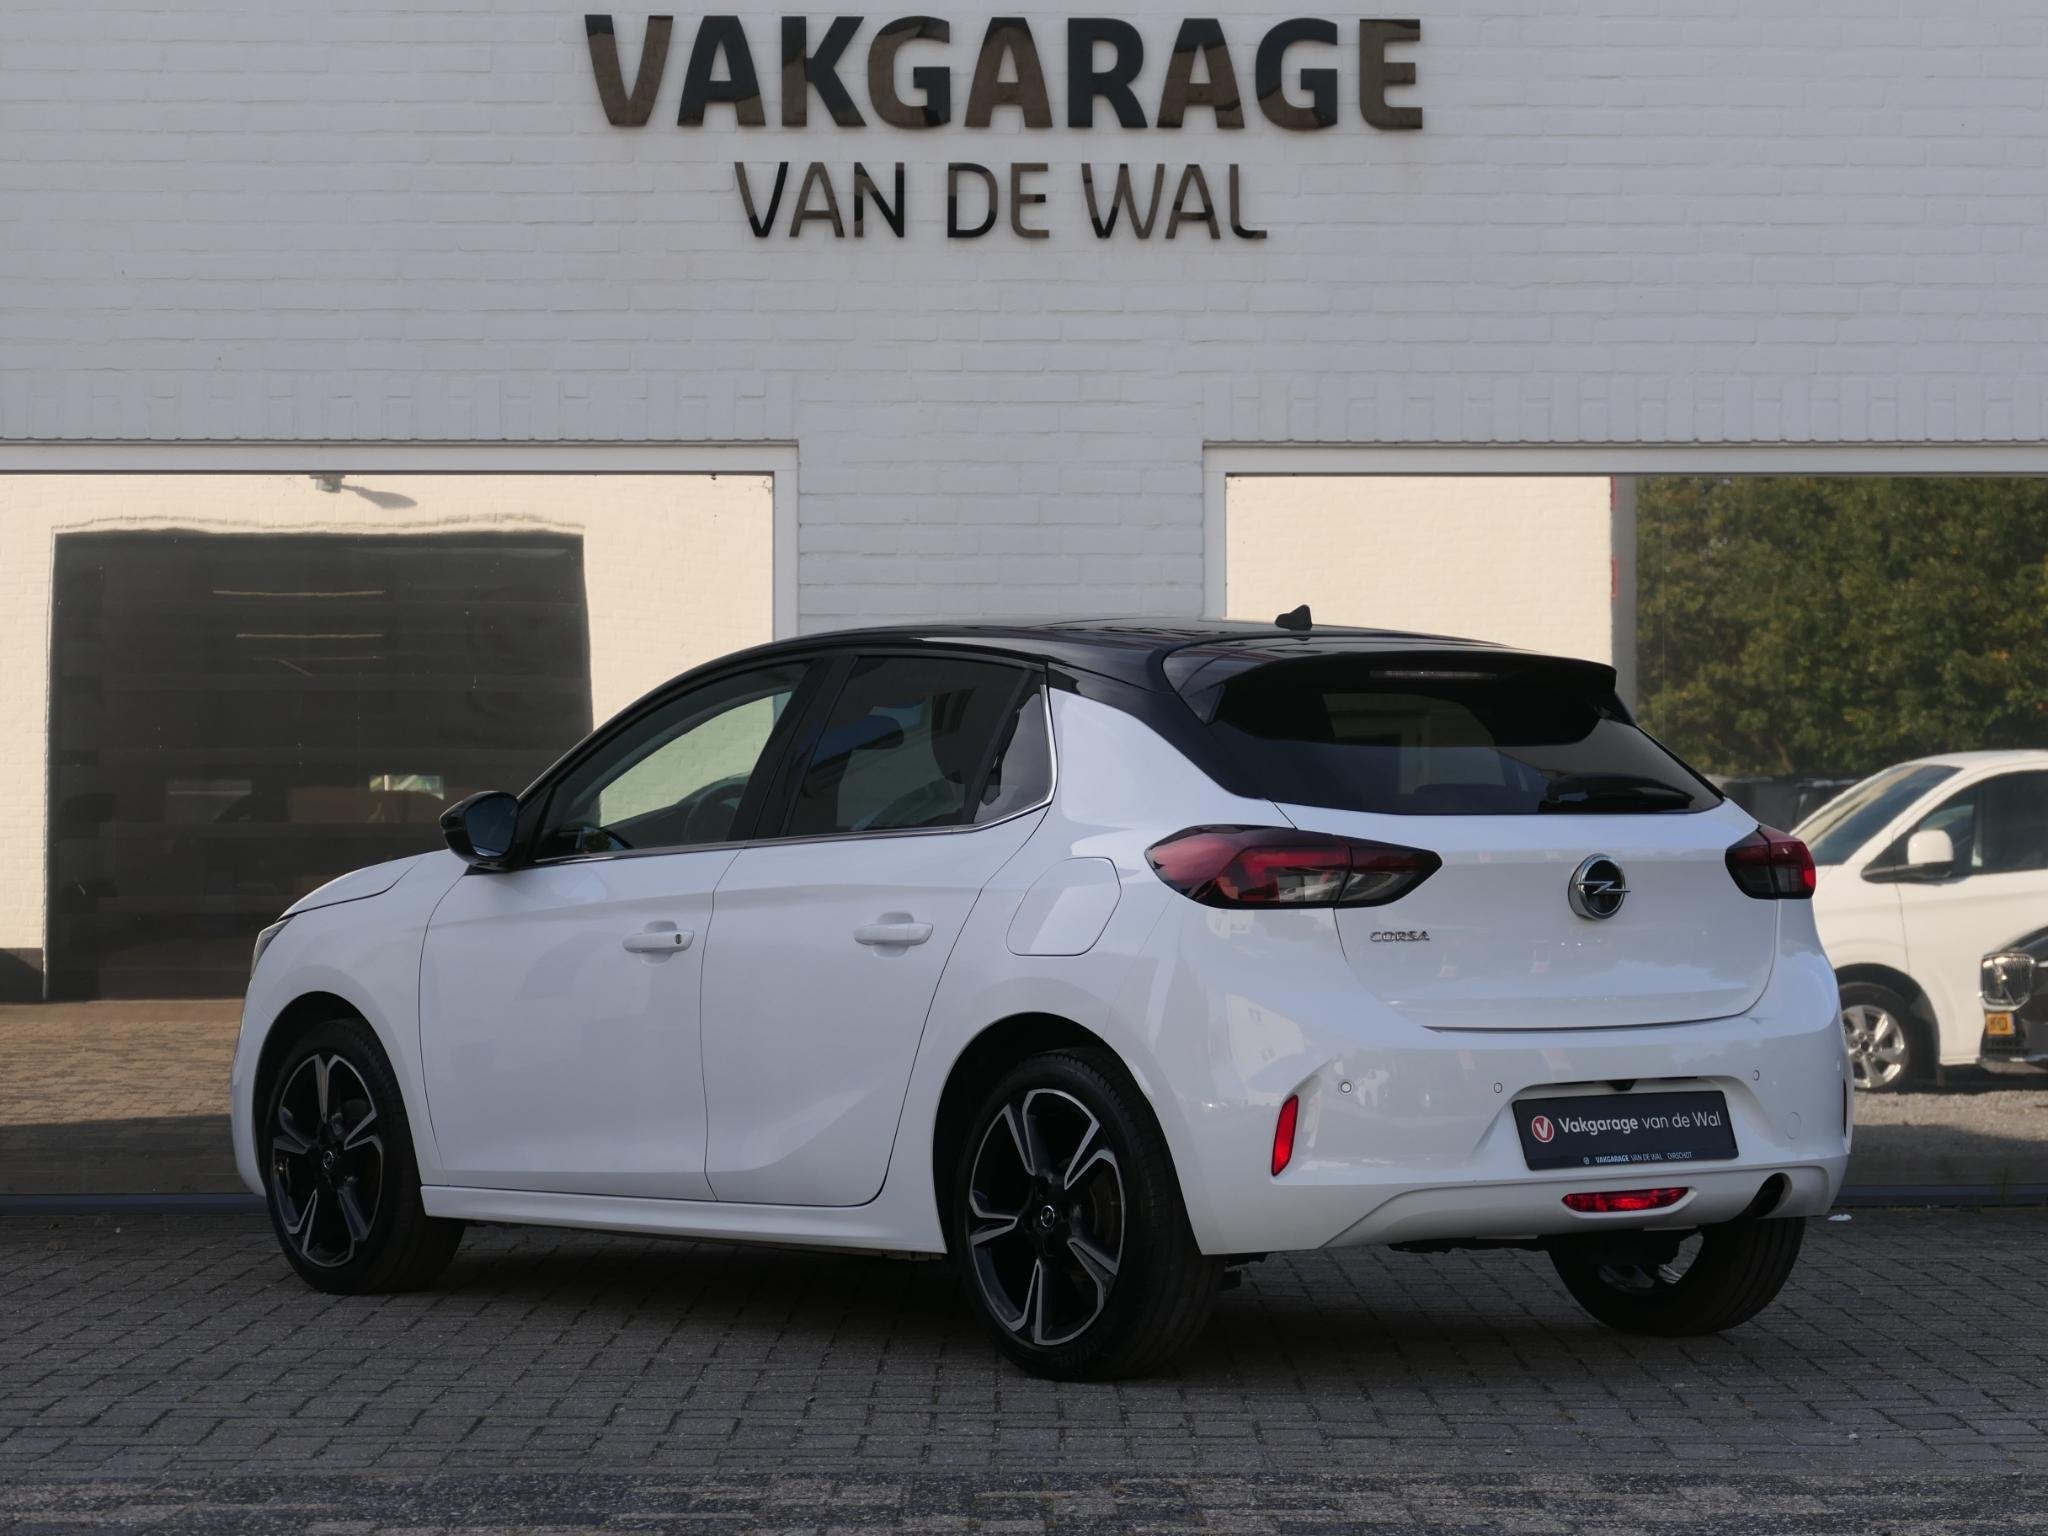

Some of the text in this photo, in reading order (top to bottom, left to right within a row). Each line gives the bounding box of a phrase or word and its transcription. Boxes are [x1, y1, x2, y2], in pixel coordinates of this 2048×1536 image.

[585, 14, 1423, 131] VAKGARAGE
[734, 161, 1268, 241] VAN DE WAL
[1369, 930, 1430, 943] CORSA
[1558, 1111, 1721, 1136] Vakgarage van de Wal
[1595, 1154, 1630, 1164] VAKGARAGE
[1631, 1154, 1642, 1162] VAN
